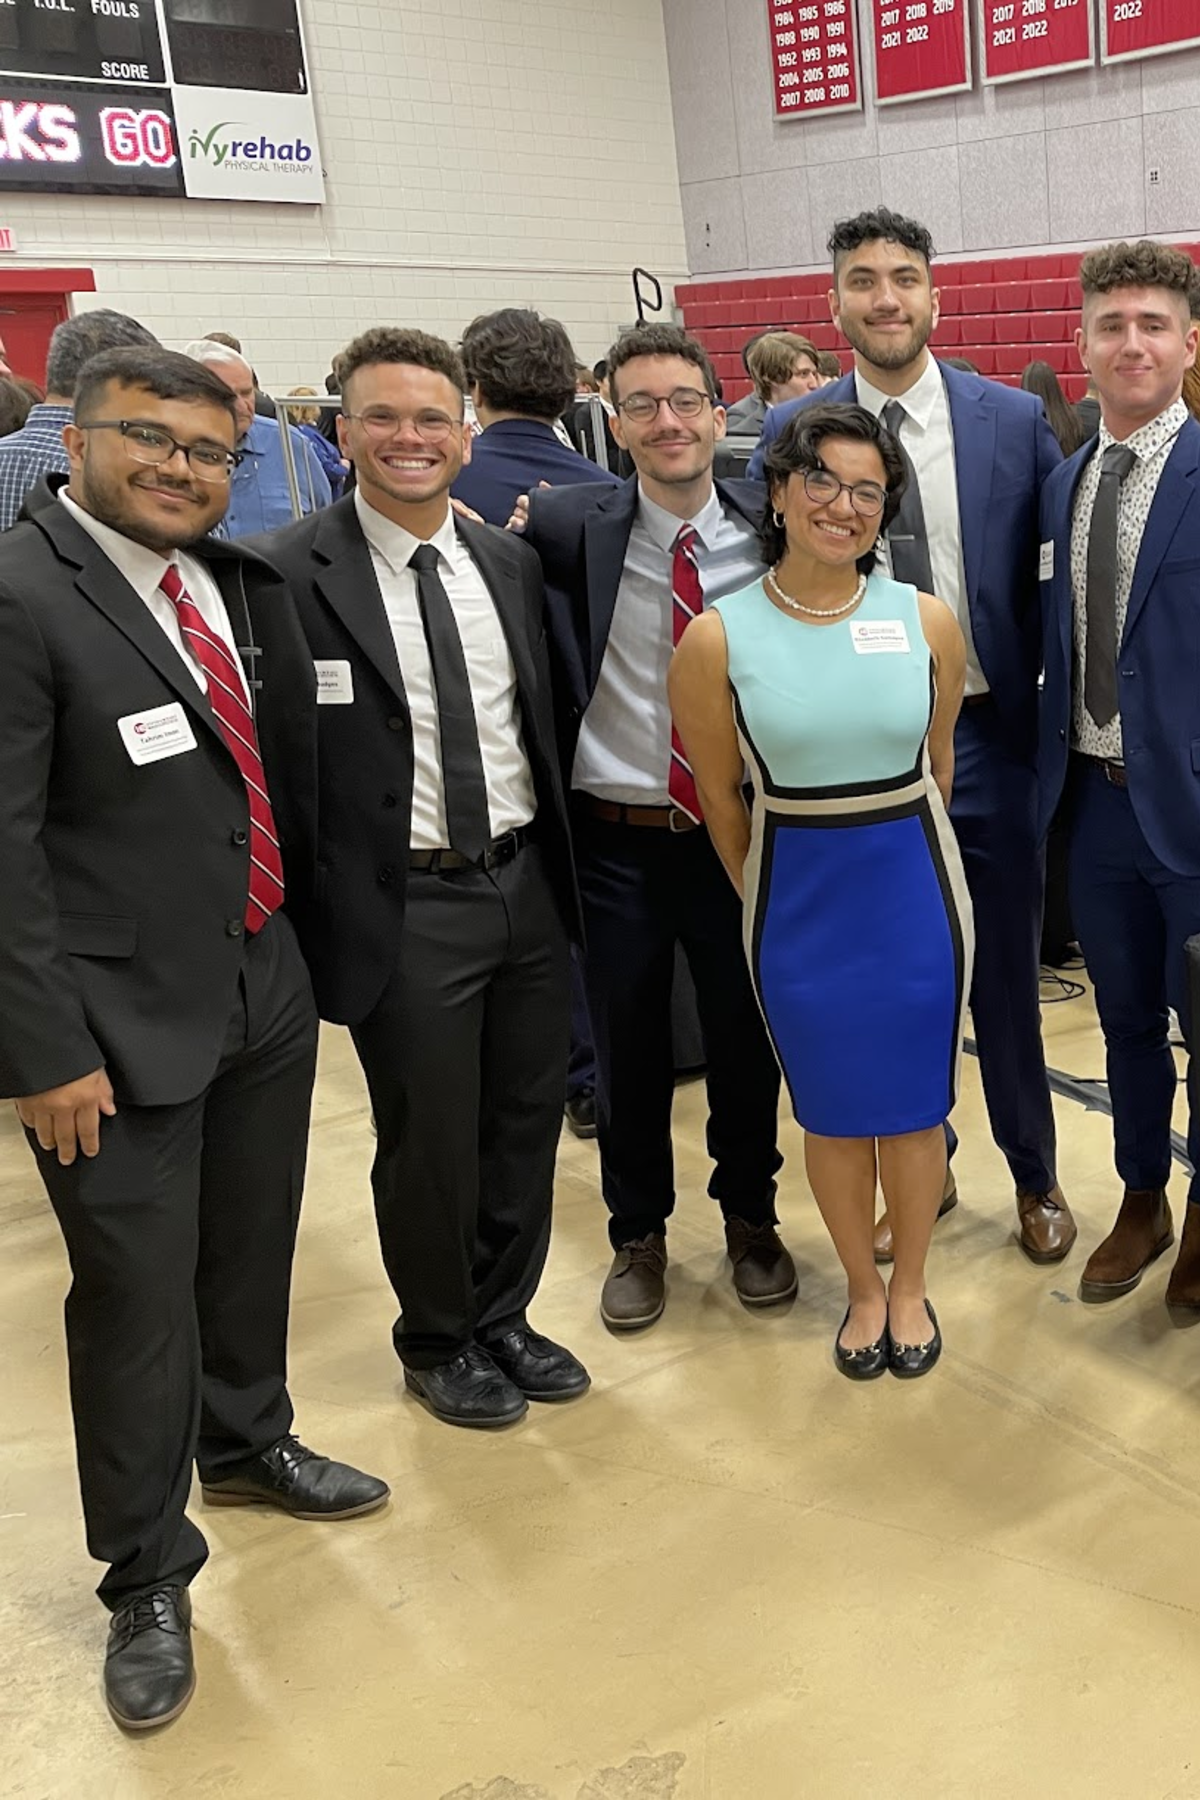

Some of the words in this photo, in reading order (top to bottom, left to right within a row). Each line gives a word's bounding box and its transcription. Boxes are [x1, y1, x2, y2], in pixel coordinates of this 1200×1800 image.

[91, 0, 140, 18] FOULS
[881, 9, 900, 27] 2017
[906, 3, 927, 21] 2018
[992, 4, 1014, 23] 2017
[1022, 0, 1046, 16] 2018
[1113, 1, 1142, 21] 2022
[800, 26, 819, 42] 1990
[826, 21, 845, 37] 1991
[881, 31, 901, 49] 2021
[906, 25, 928, 43] 2022
[993, 28, 1015, 46] 2021
[1022, 20, 1048, 40] 2022
[778, 52, 797, 67] 1992
[802, 47, 821, 62] 1993
[101, 62, 150, 79] SCORE
[803, 67, 824, 83] 2005
[827, 63, 849, 79] 2006
[781, 91, 801, 107] 2007
[830, 84, 849, 99] 2010
[0, 100, 81, 162] KS
[98, 106, 176, 168] GO
[224, 160, 270, 172] PHYSICAL
[273, 163, 313, 175] THERAPY
